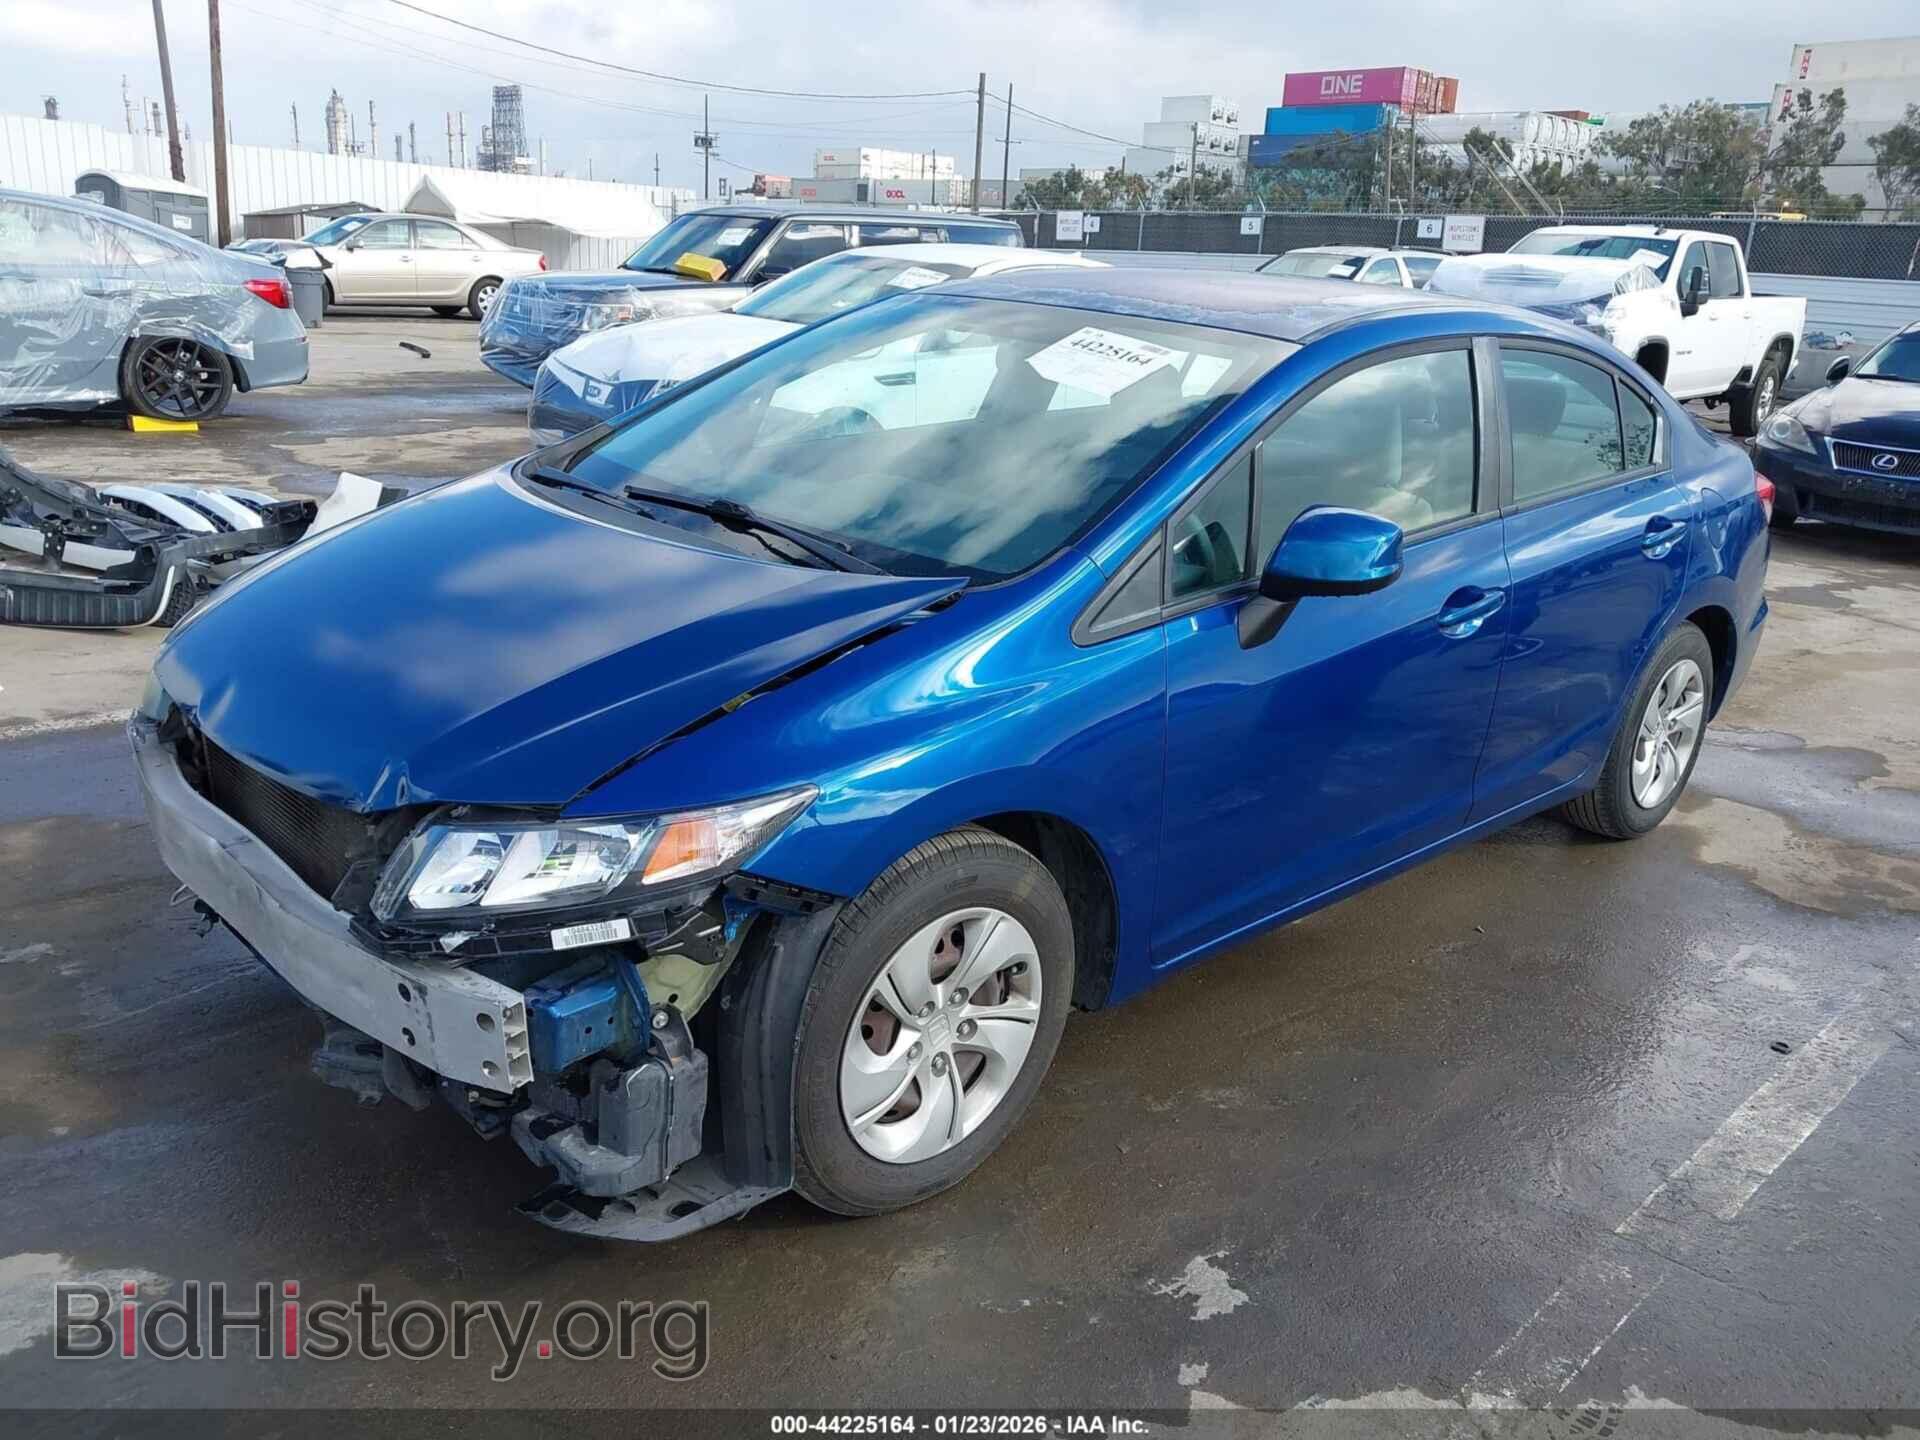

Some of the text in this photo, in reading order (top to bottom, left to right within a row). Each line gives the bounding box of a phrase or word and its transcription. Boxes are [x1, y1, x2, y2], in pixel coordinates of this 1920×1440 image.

[1320, 74, 1363, 95] ONE
[1247, 221, 1254, 231] 5
[1426, 223, 1433, 234] 6
[1071, 338, 1152, 366] 44225164
